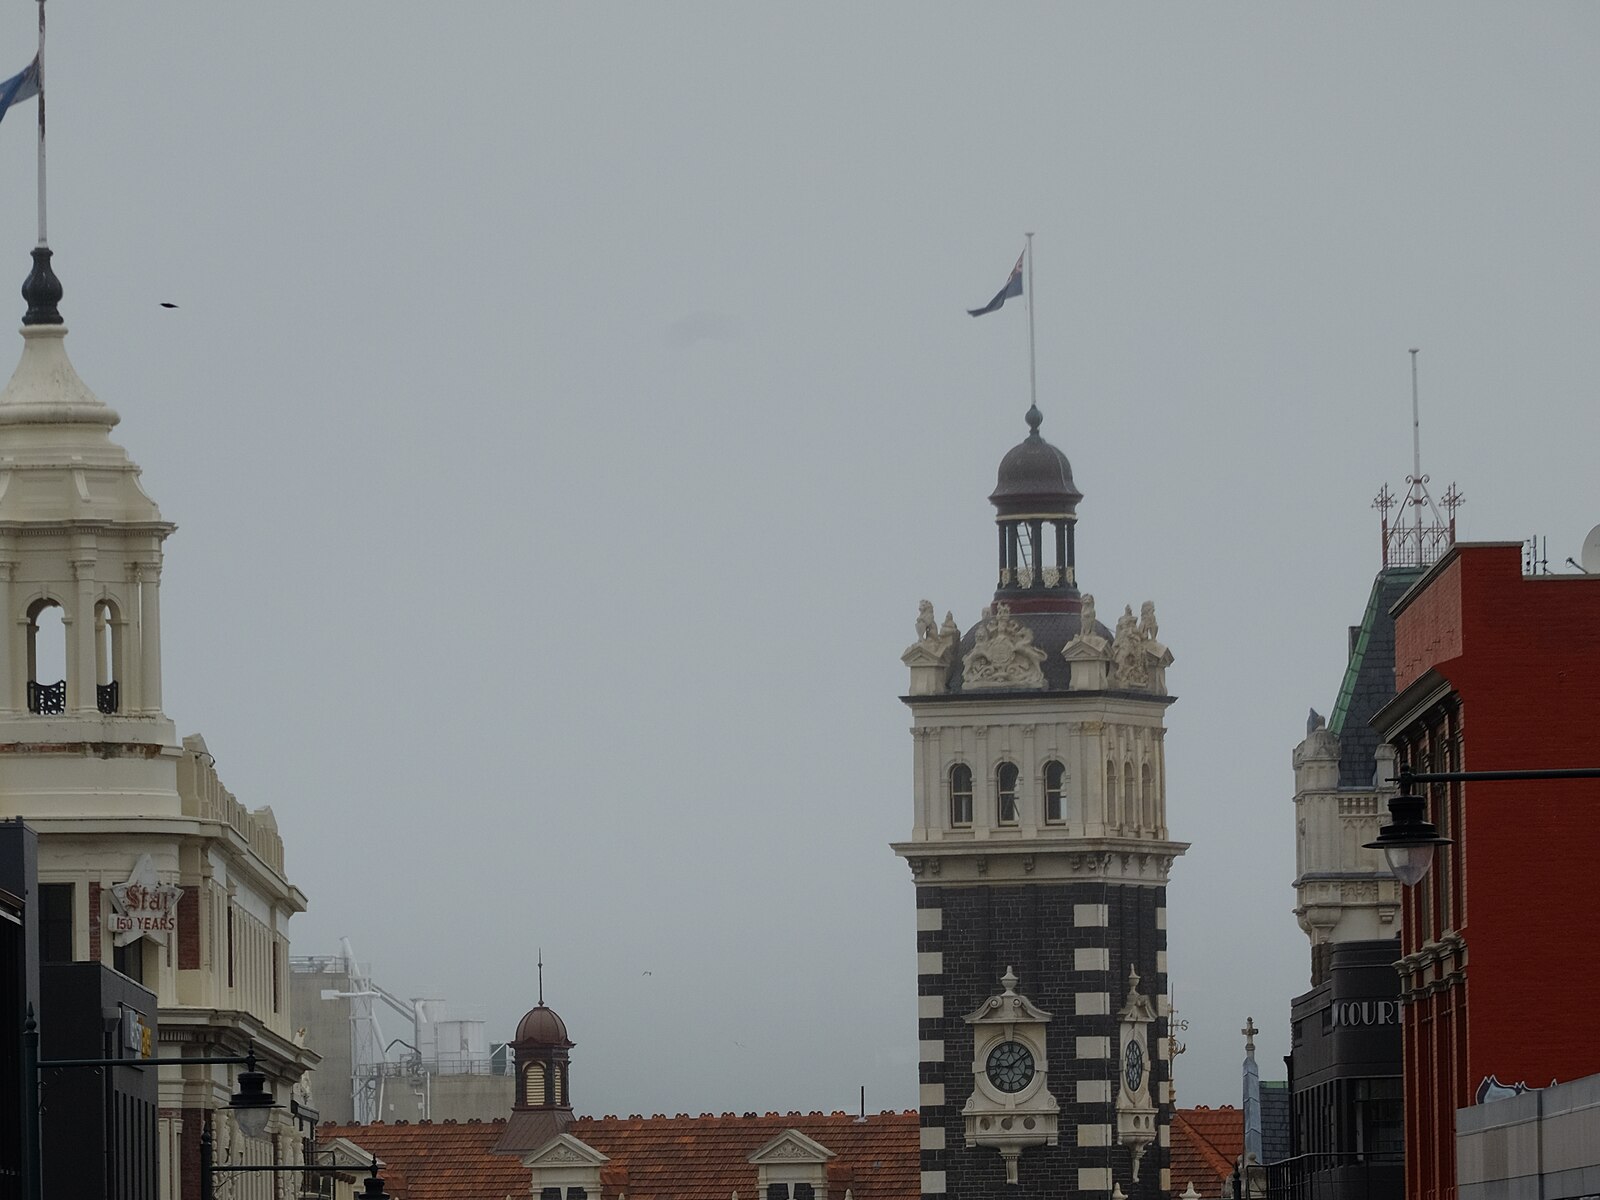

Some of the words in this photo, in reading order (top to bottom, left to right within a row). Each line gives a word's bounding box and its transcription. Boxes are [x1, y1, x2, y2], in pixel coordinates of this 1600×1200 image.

[125, 884, 176, 911] Star
[116, 917, 133, 930] 150
[137, 917, 175, 931] YEARS
